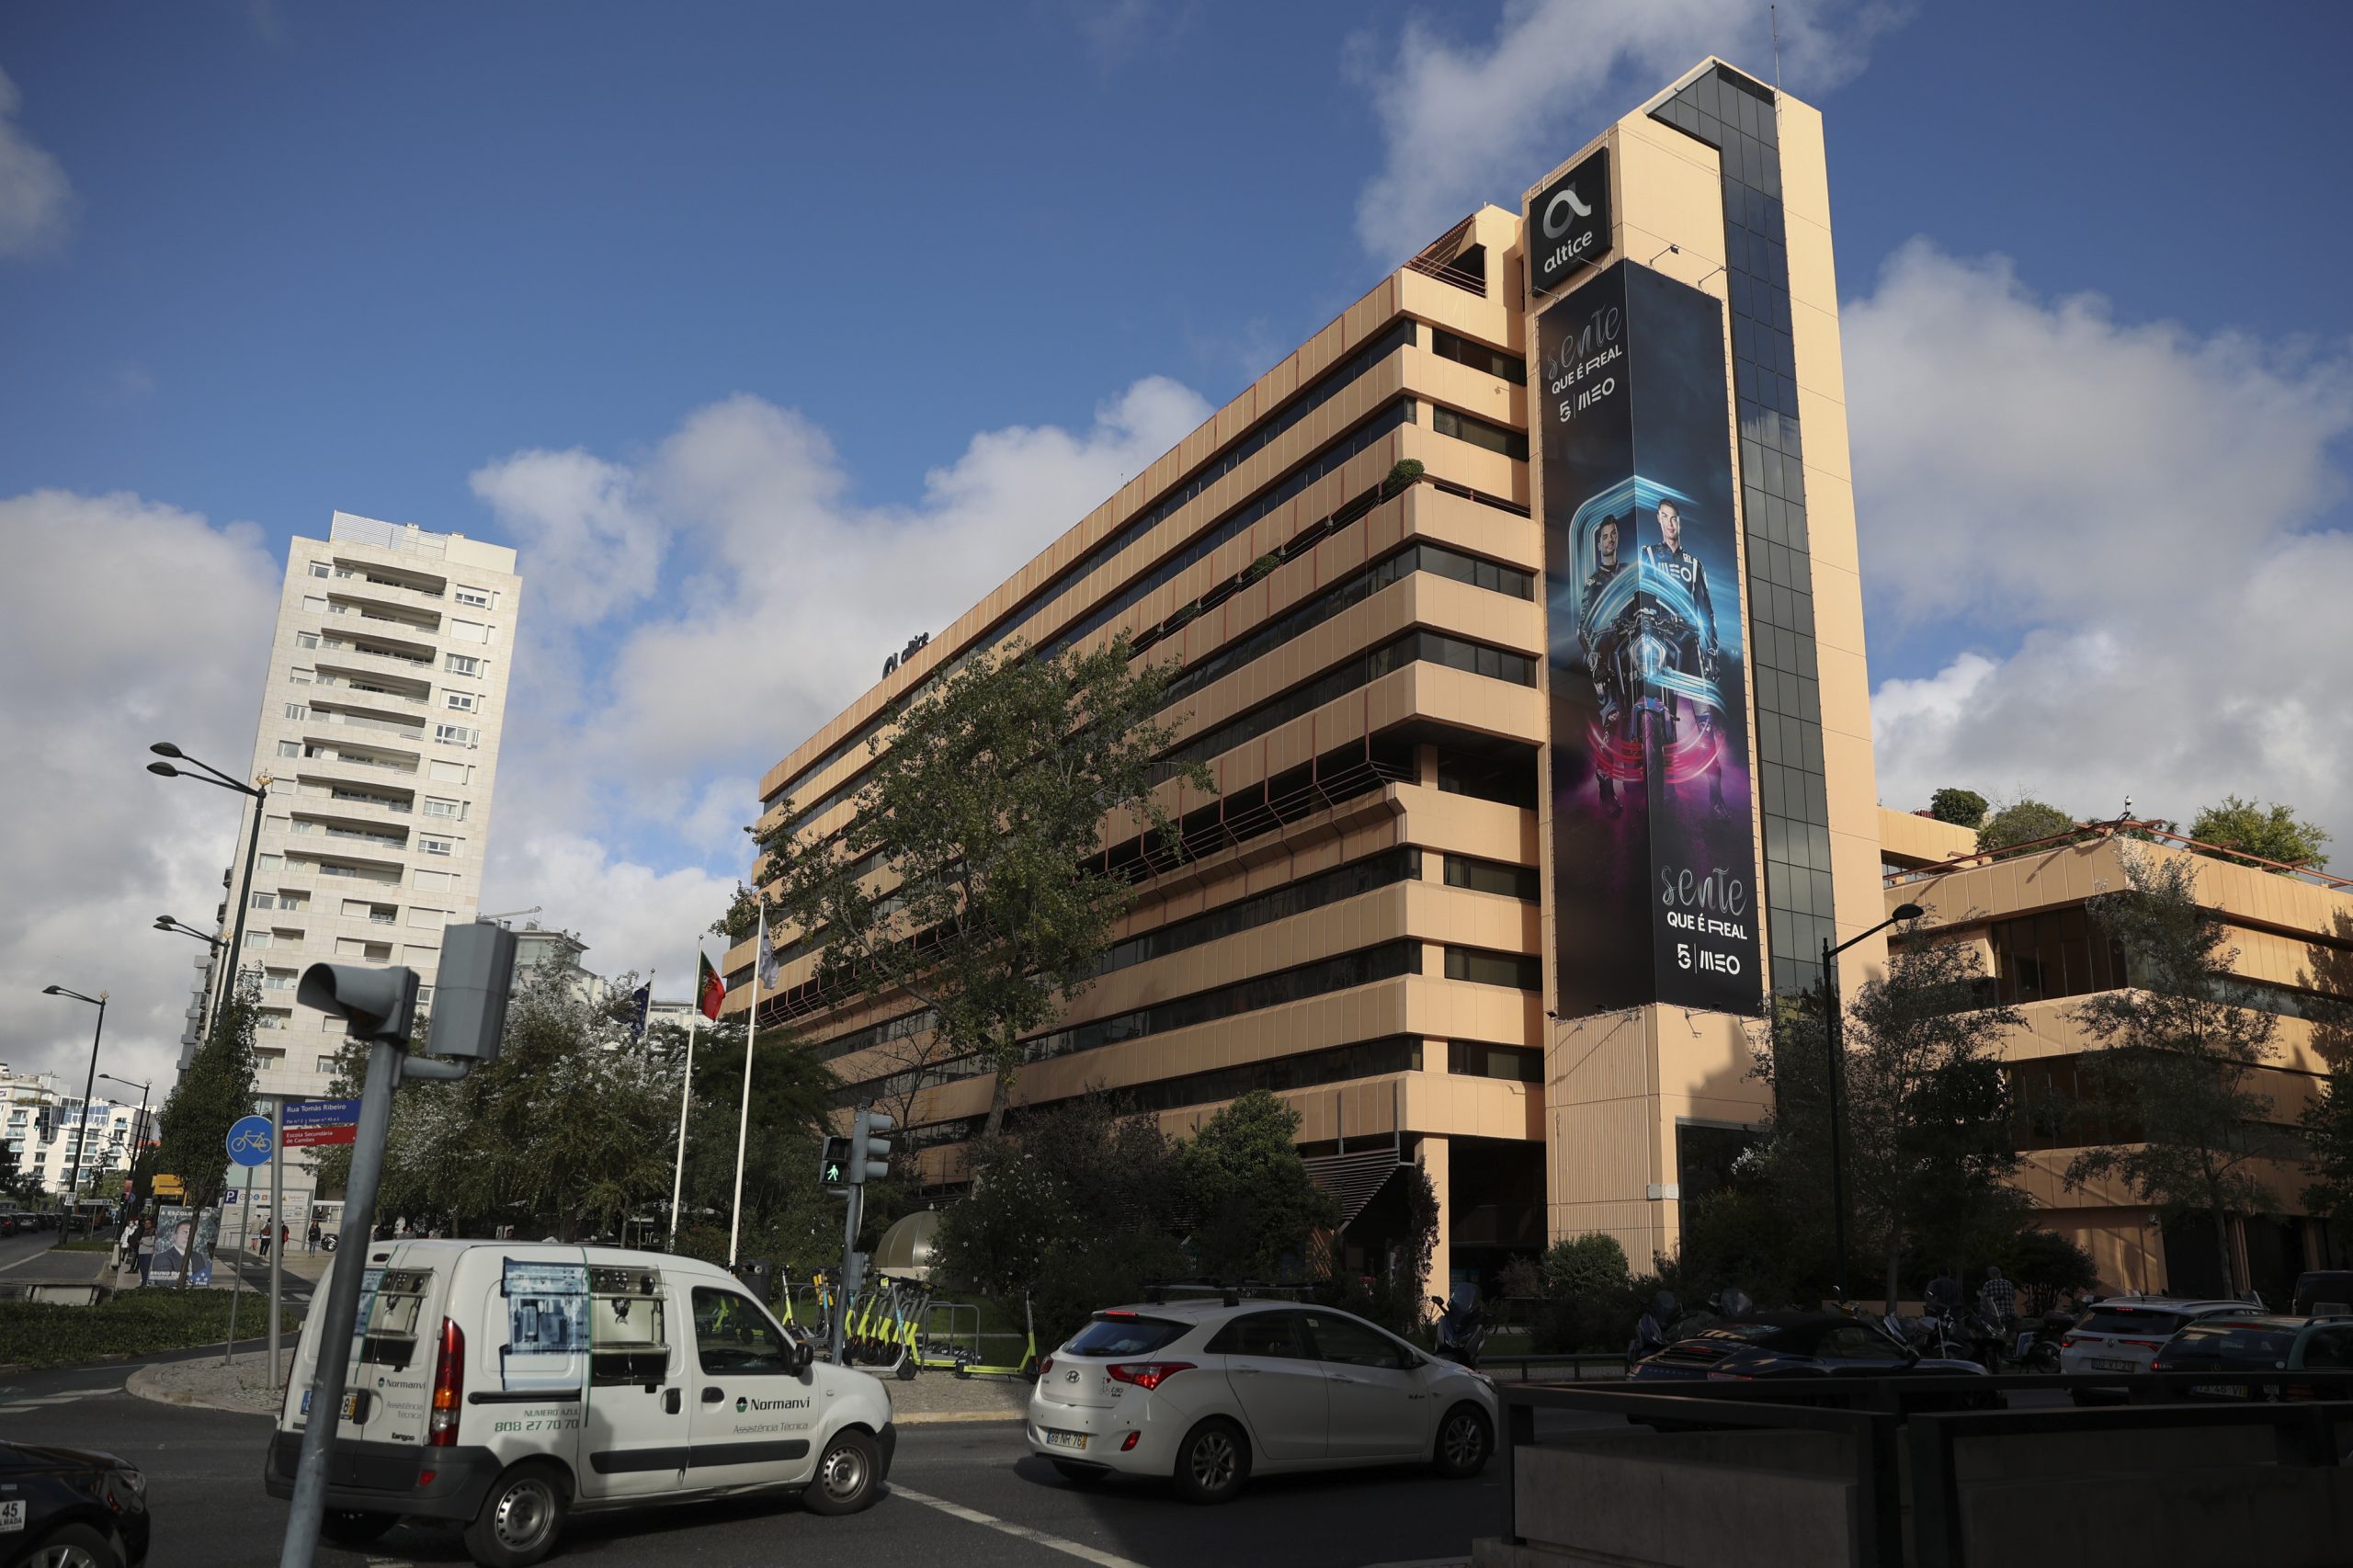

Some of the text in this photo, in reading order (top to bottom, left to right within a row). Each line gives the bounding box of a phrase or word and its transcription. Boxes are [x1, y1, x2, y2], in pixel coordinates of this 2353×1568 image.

[1544, 231, 1593, 274] altice
[1552, 345, 1622, 394] QUE É REAL
[1578, 377, 1615, 412] MEO
[1667, 911, 1748, 940] QUE É REAL
[1699, 949, 1741, 975] MEO
[386, 1379, 426, 1390] Normanvi
[750, 1396, 810, 1411] Normanvi
[494, 1419, 579, 1432] 808 27 70 70
[2, 1502, 18, 1517] 45
